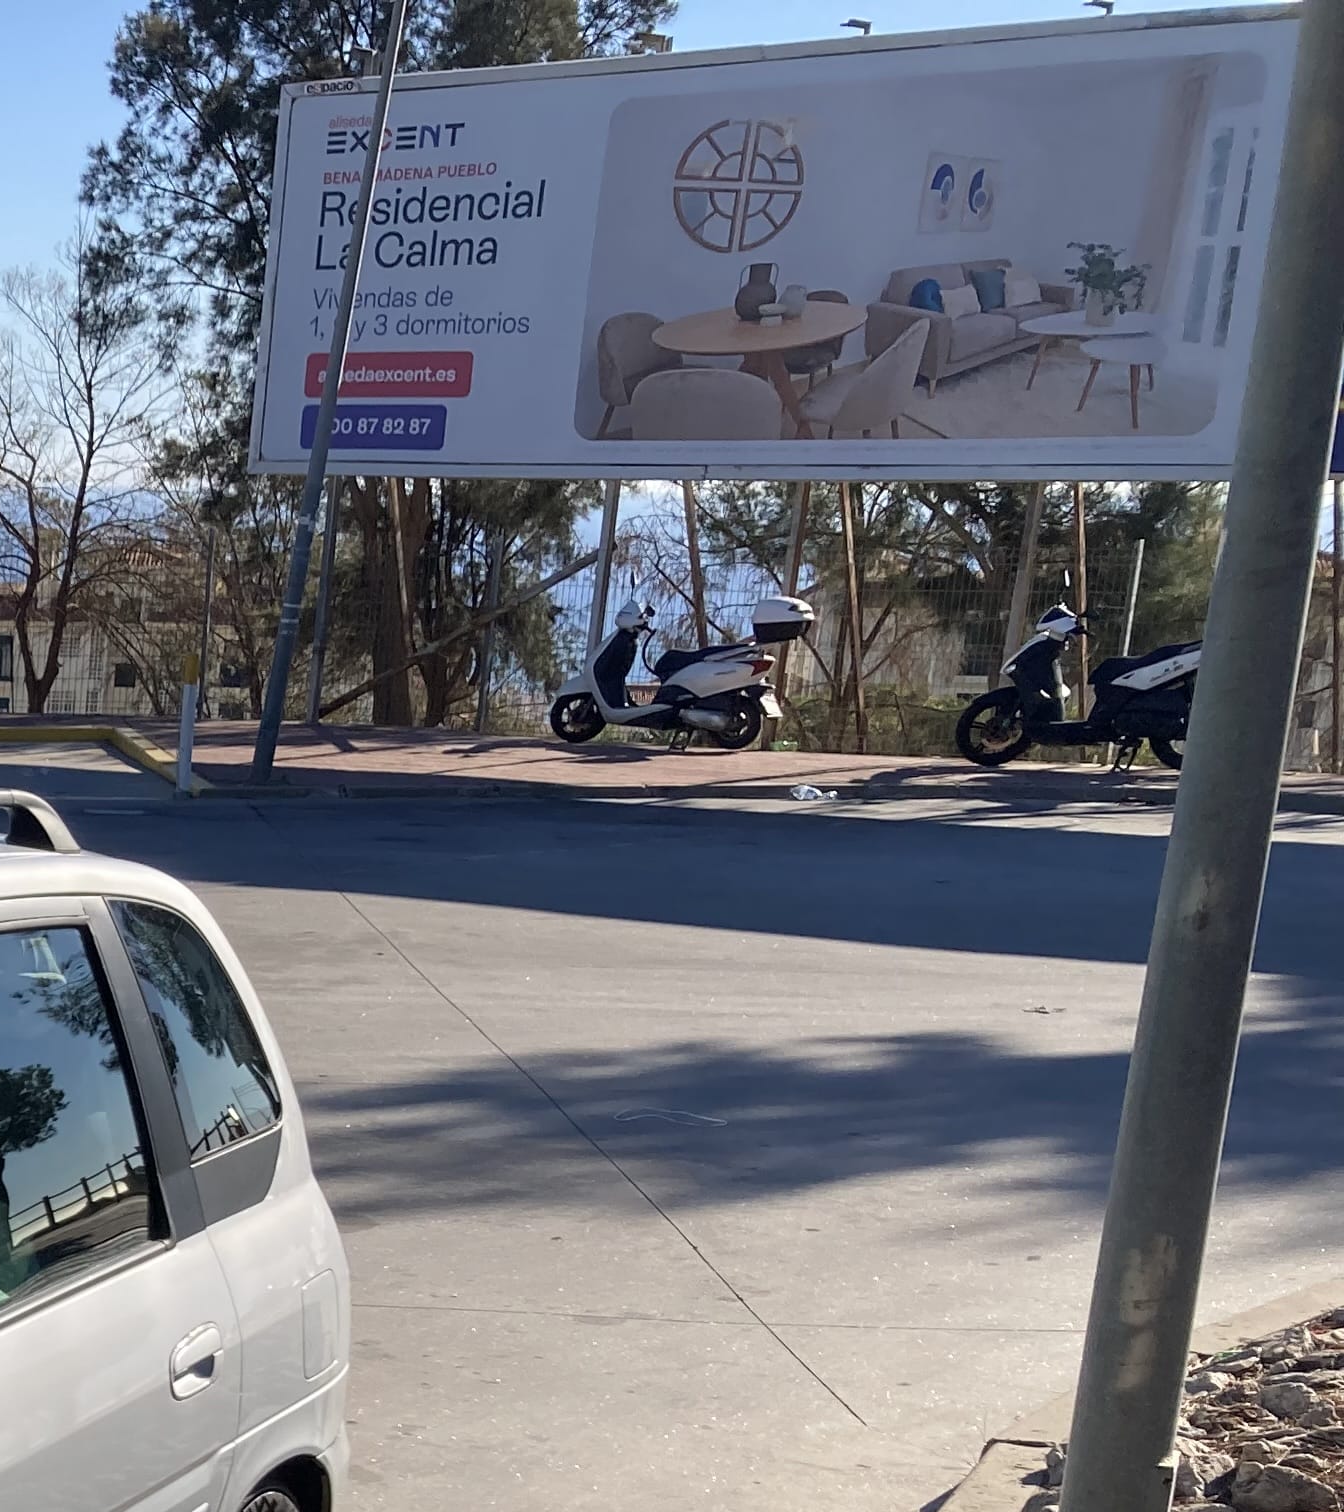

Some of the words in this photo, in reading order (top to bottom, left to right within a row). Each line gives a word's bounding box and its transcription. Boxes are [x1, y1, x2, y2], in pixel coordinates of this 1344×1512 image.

[438, 162, 497, 179] PUEBLO
[319, 179, 546, 227] Residencial
[374, 230, 499, 269] Calma
[425, 285, 453, 307] de
[373, 315, 388, 336] 3
[395, 312, 530, 336] dormitorios
[357, 417, 379, 435] 87
[382, 417, 405, 435] 82
[409, 417, 432, 435] 87
